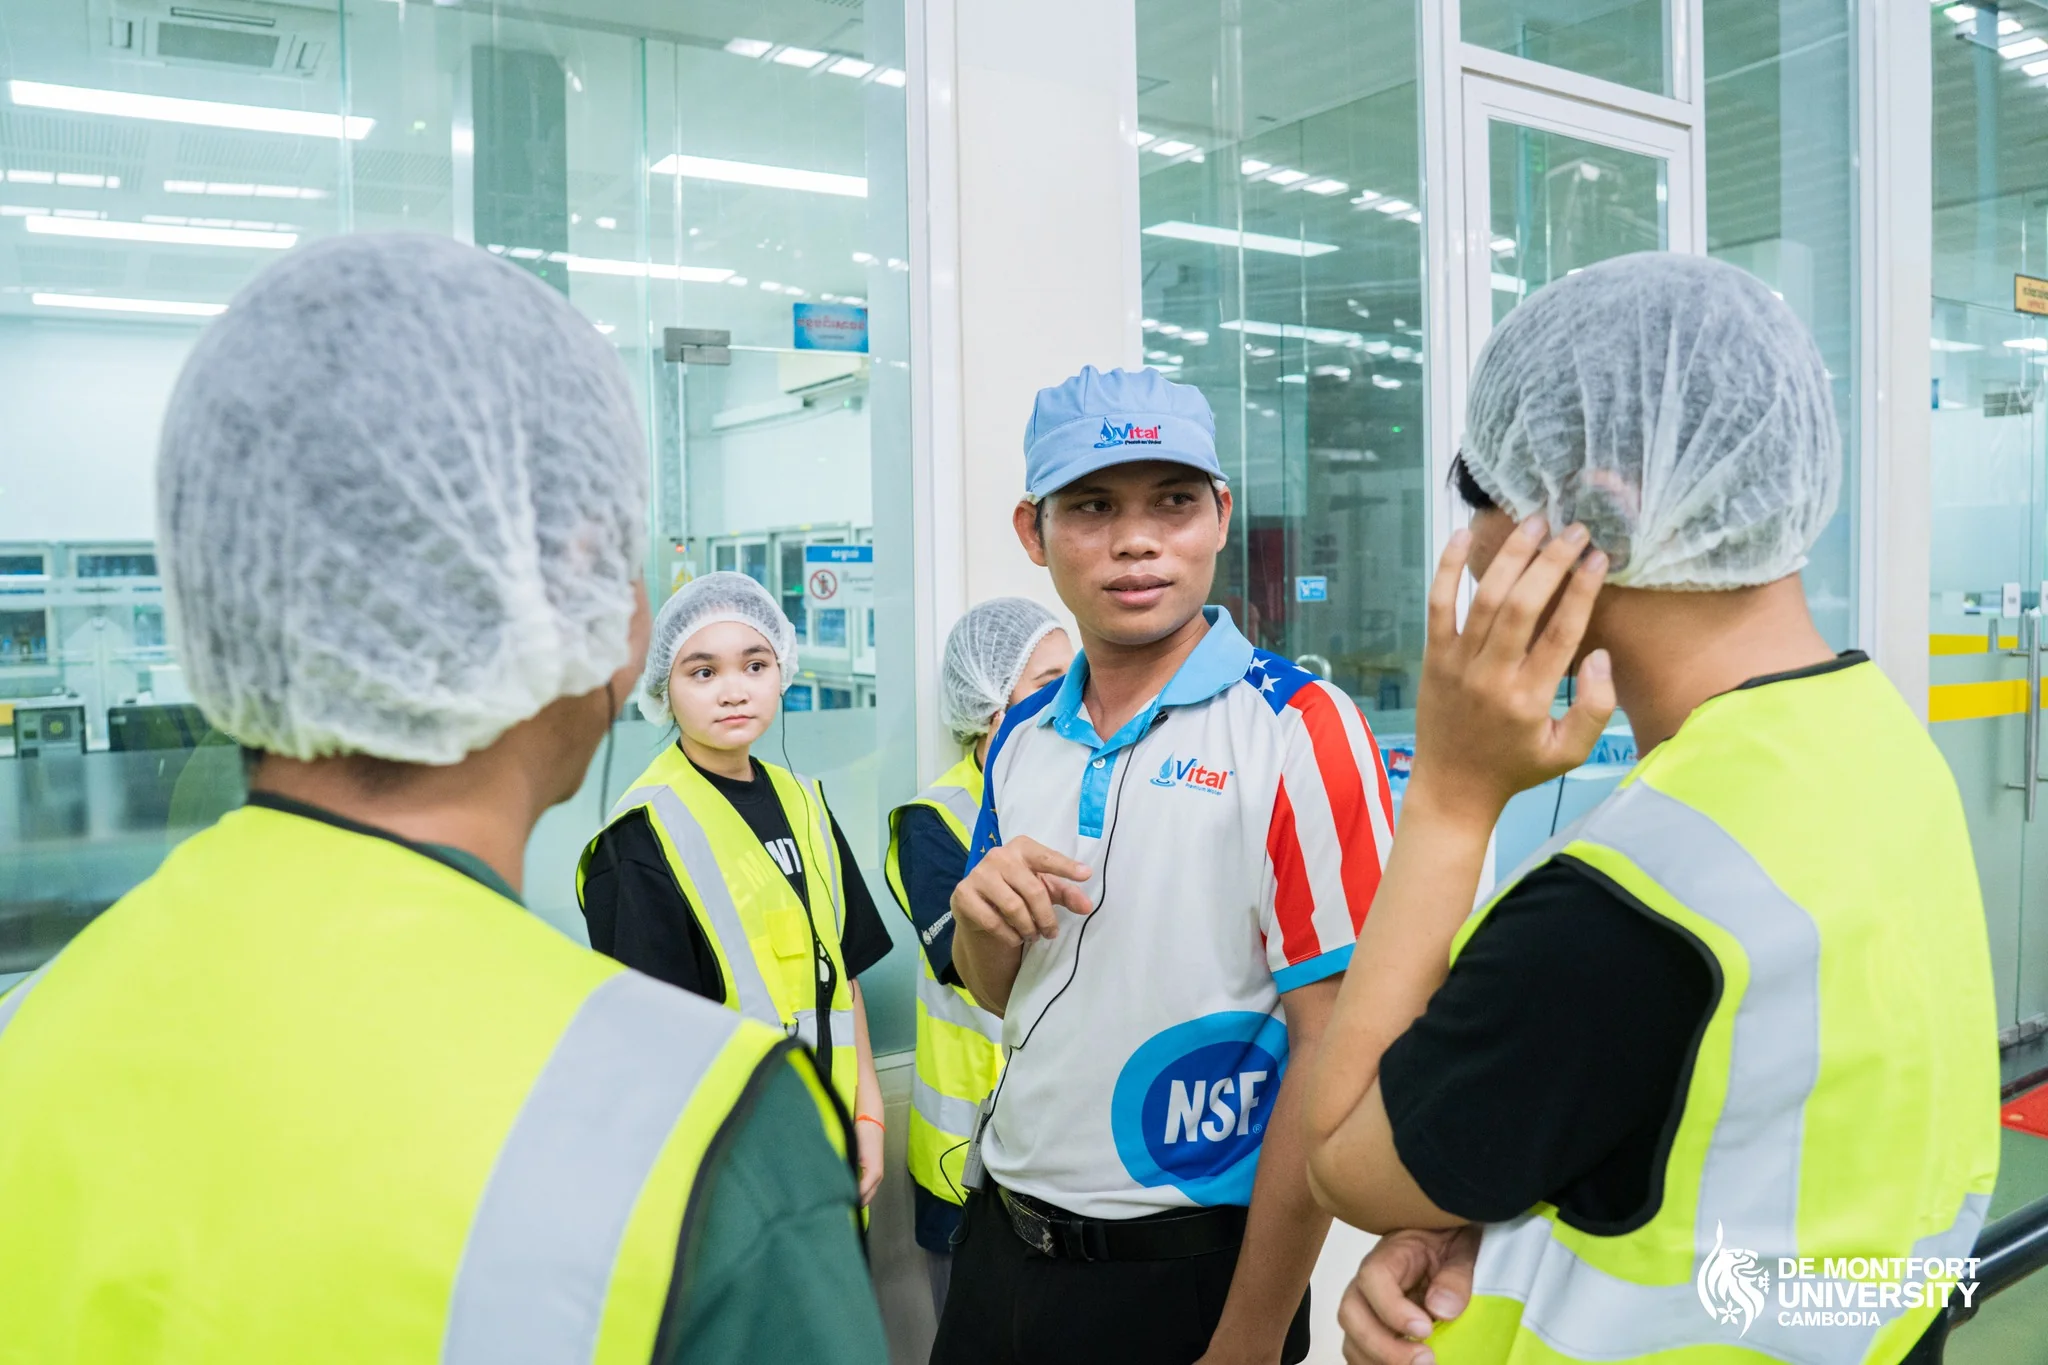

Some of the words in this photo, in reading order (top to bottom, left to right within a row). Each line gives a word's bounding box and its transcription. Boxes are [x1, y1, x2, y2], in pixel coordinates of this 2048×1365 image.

[1115, 423, 1159, 440] Vital
[1176, 758, 1229, 790] Vital
[1163, 1070, 1268, 1145] NSF
